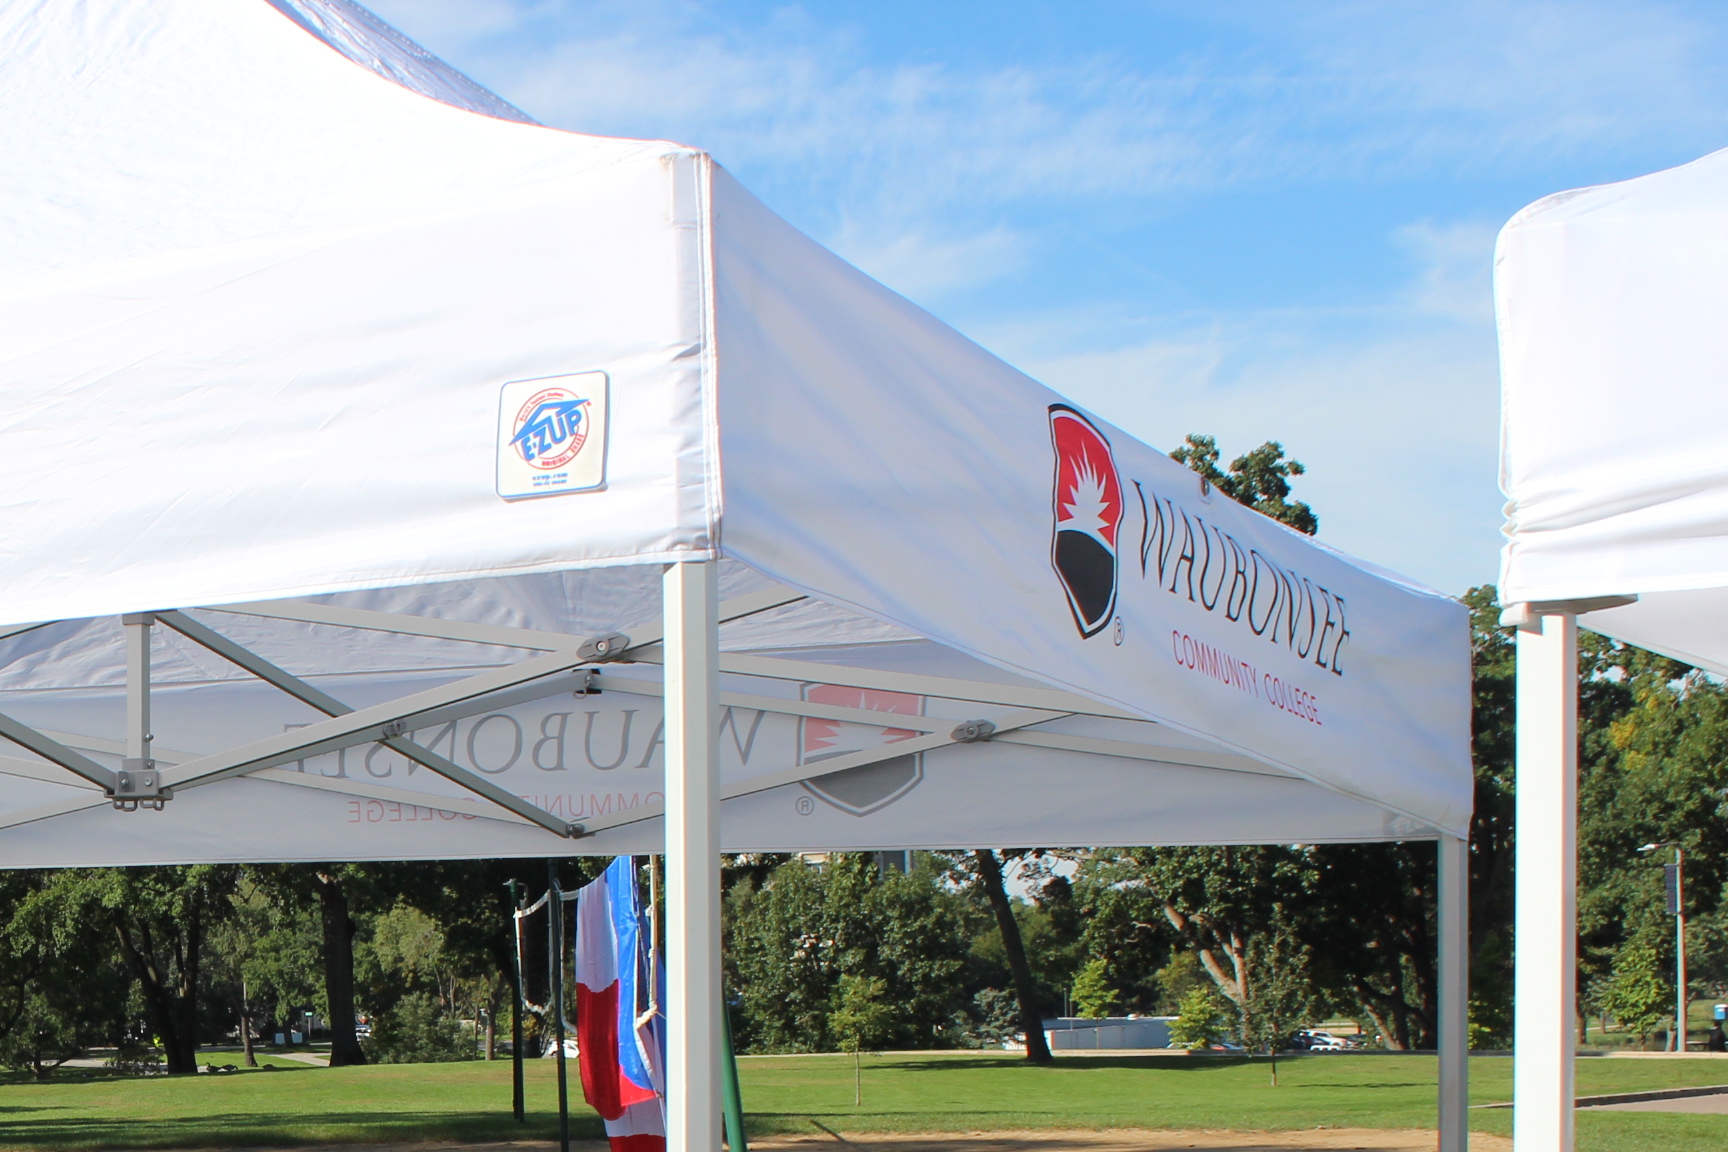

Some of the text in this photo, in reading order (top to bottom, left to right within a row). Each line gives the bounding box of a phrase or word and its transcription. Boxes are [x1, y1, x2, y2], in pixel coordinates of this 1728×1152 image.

[1130, 477, 1351, 677] WAUBONSEE
[1172, 629, 1323, 726] COMMUNITY COLLEGE
